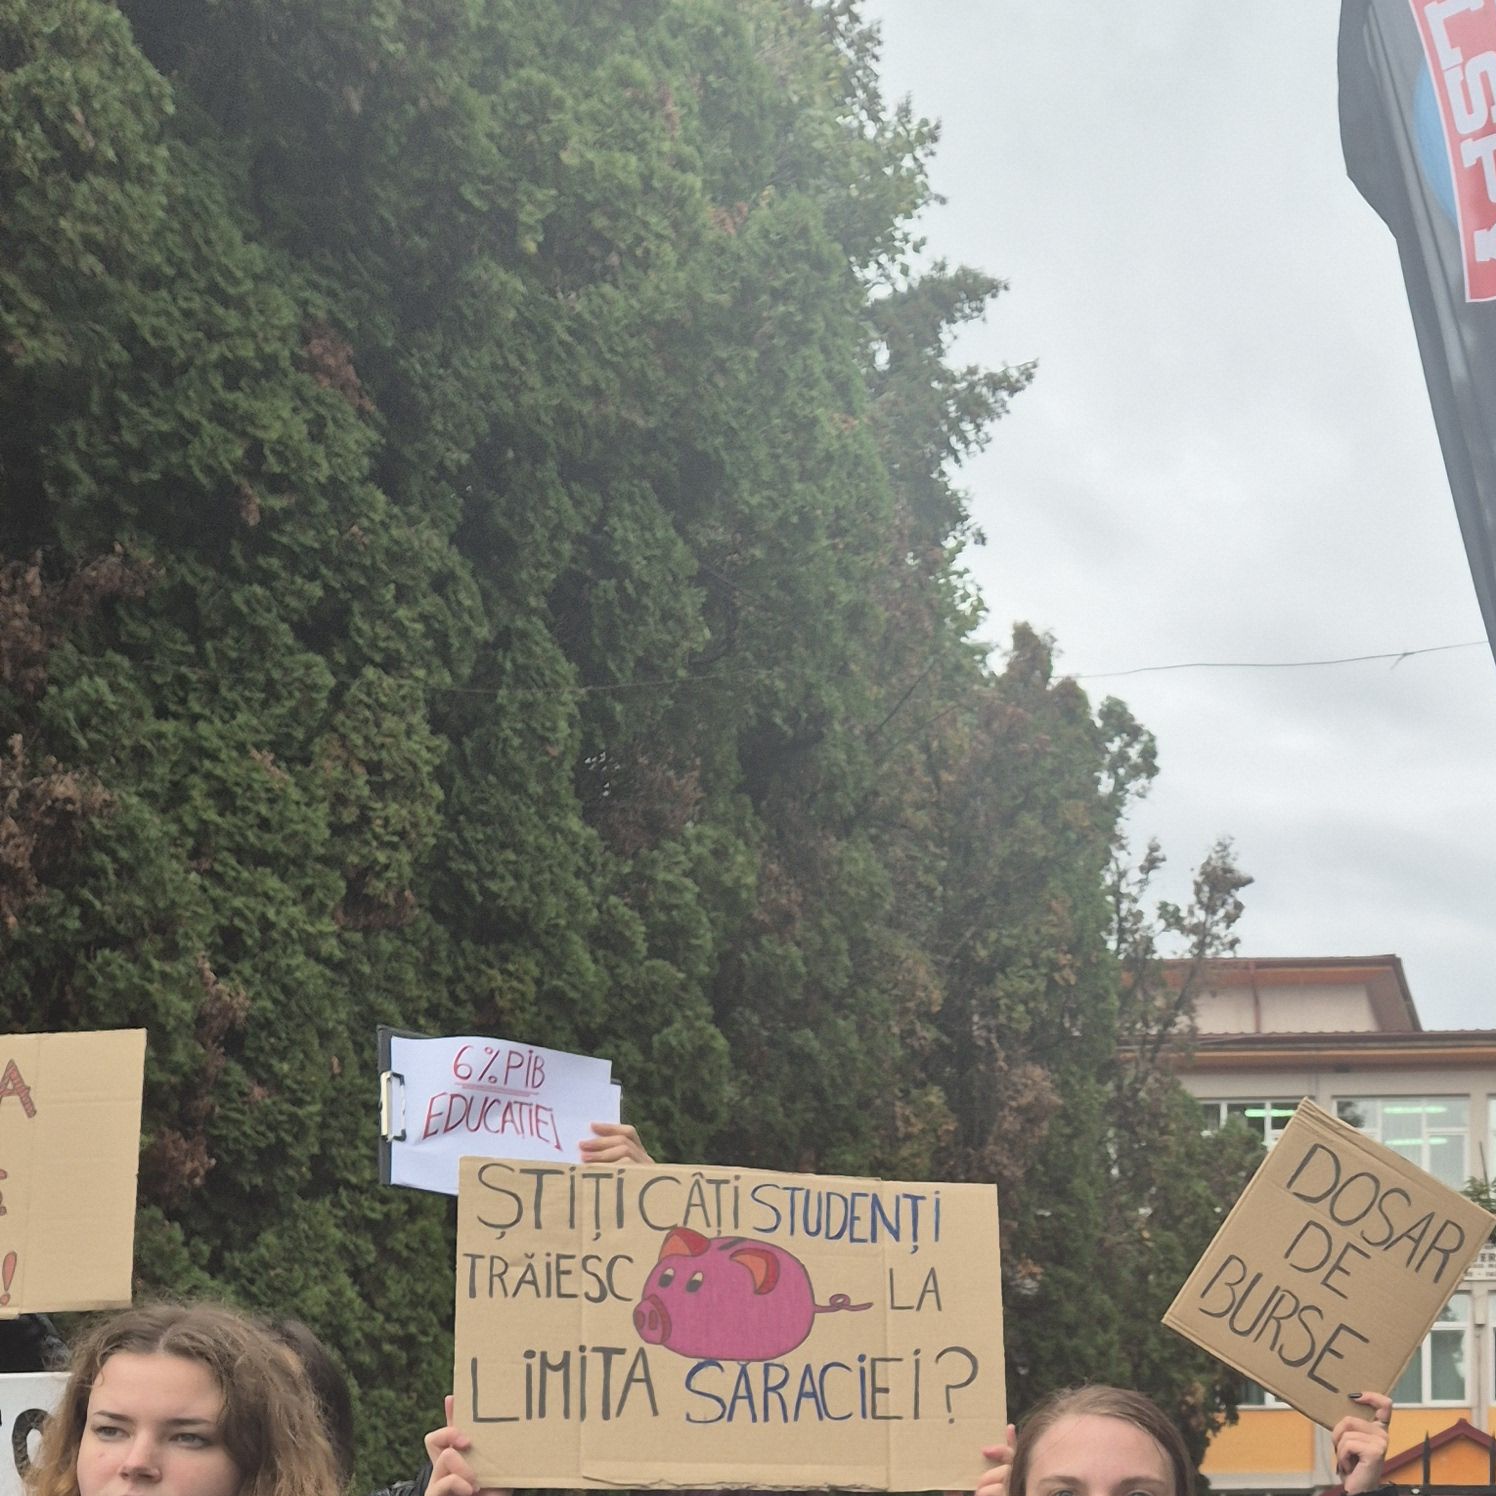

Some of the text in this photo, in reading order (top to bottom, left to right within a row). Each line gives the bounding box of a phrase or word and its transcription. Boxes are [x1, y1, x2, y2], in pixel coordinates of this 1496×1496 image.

[1286, 1142, 1466, 1285] DOSAR
[888, 1266, 943, 1312] LA
[1283, 1219, 1372, 1300] DE
[1198, 1254, 1371, 1394] BURSE
[470, 1344, 660, 1424] LIMITA
